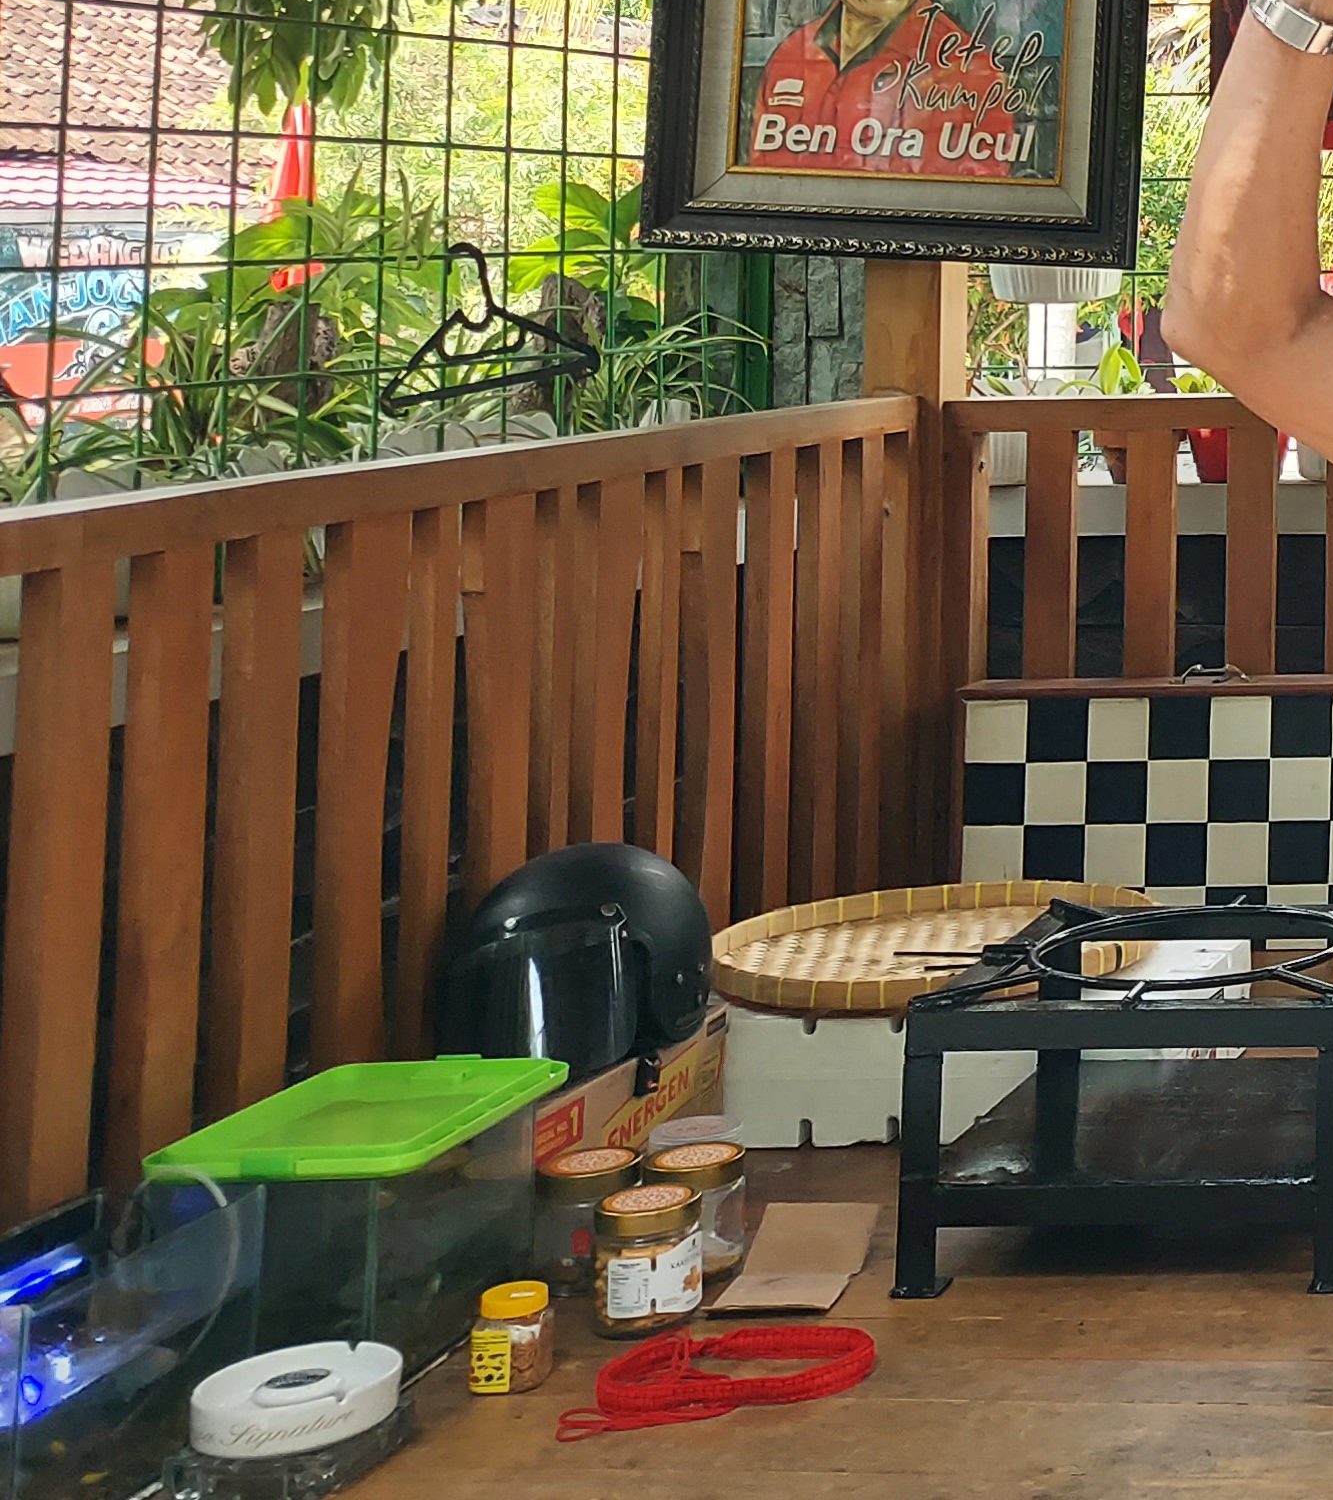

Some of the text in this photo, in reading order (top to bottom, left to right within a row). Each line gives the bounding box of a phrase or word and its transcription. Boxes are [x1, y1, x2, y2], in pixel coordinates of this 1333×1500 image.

[916, 2, 1044, 88] Tetep
[753, 114, 1035, 162] Ben Ora Ucul
[607, 1066, 690, 1149] ENERGEN
